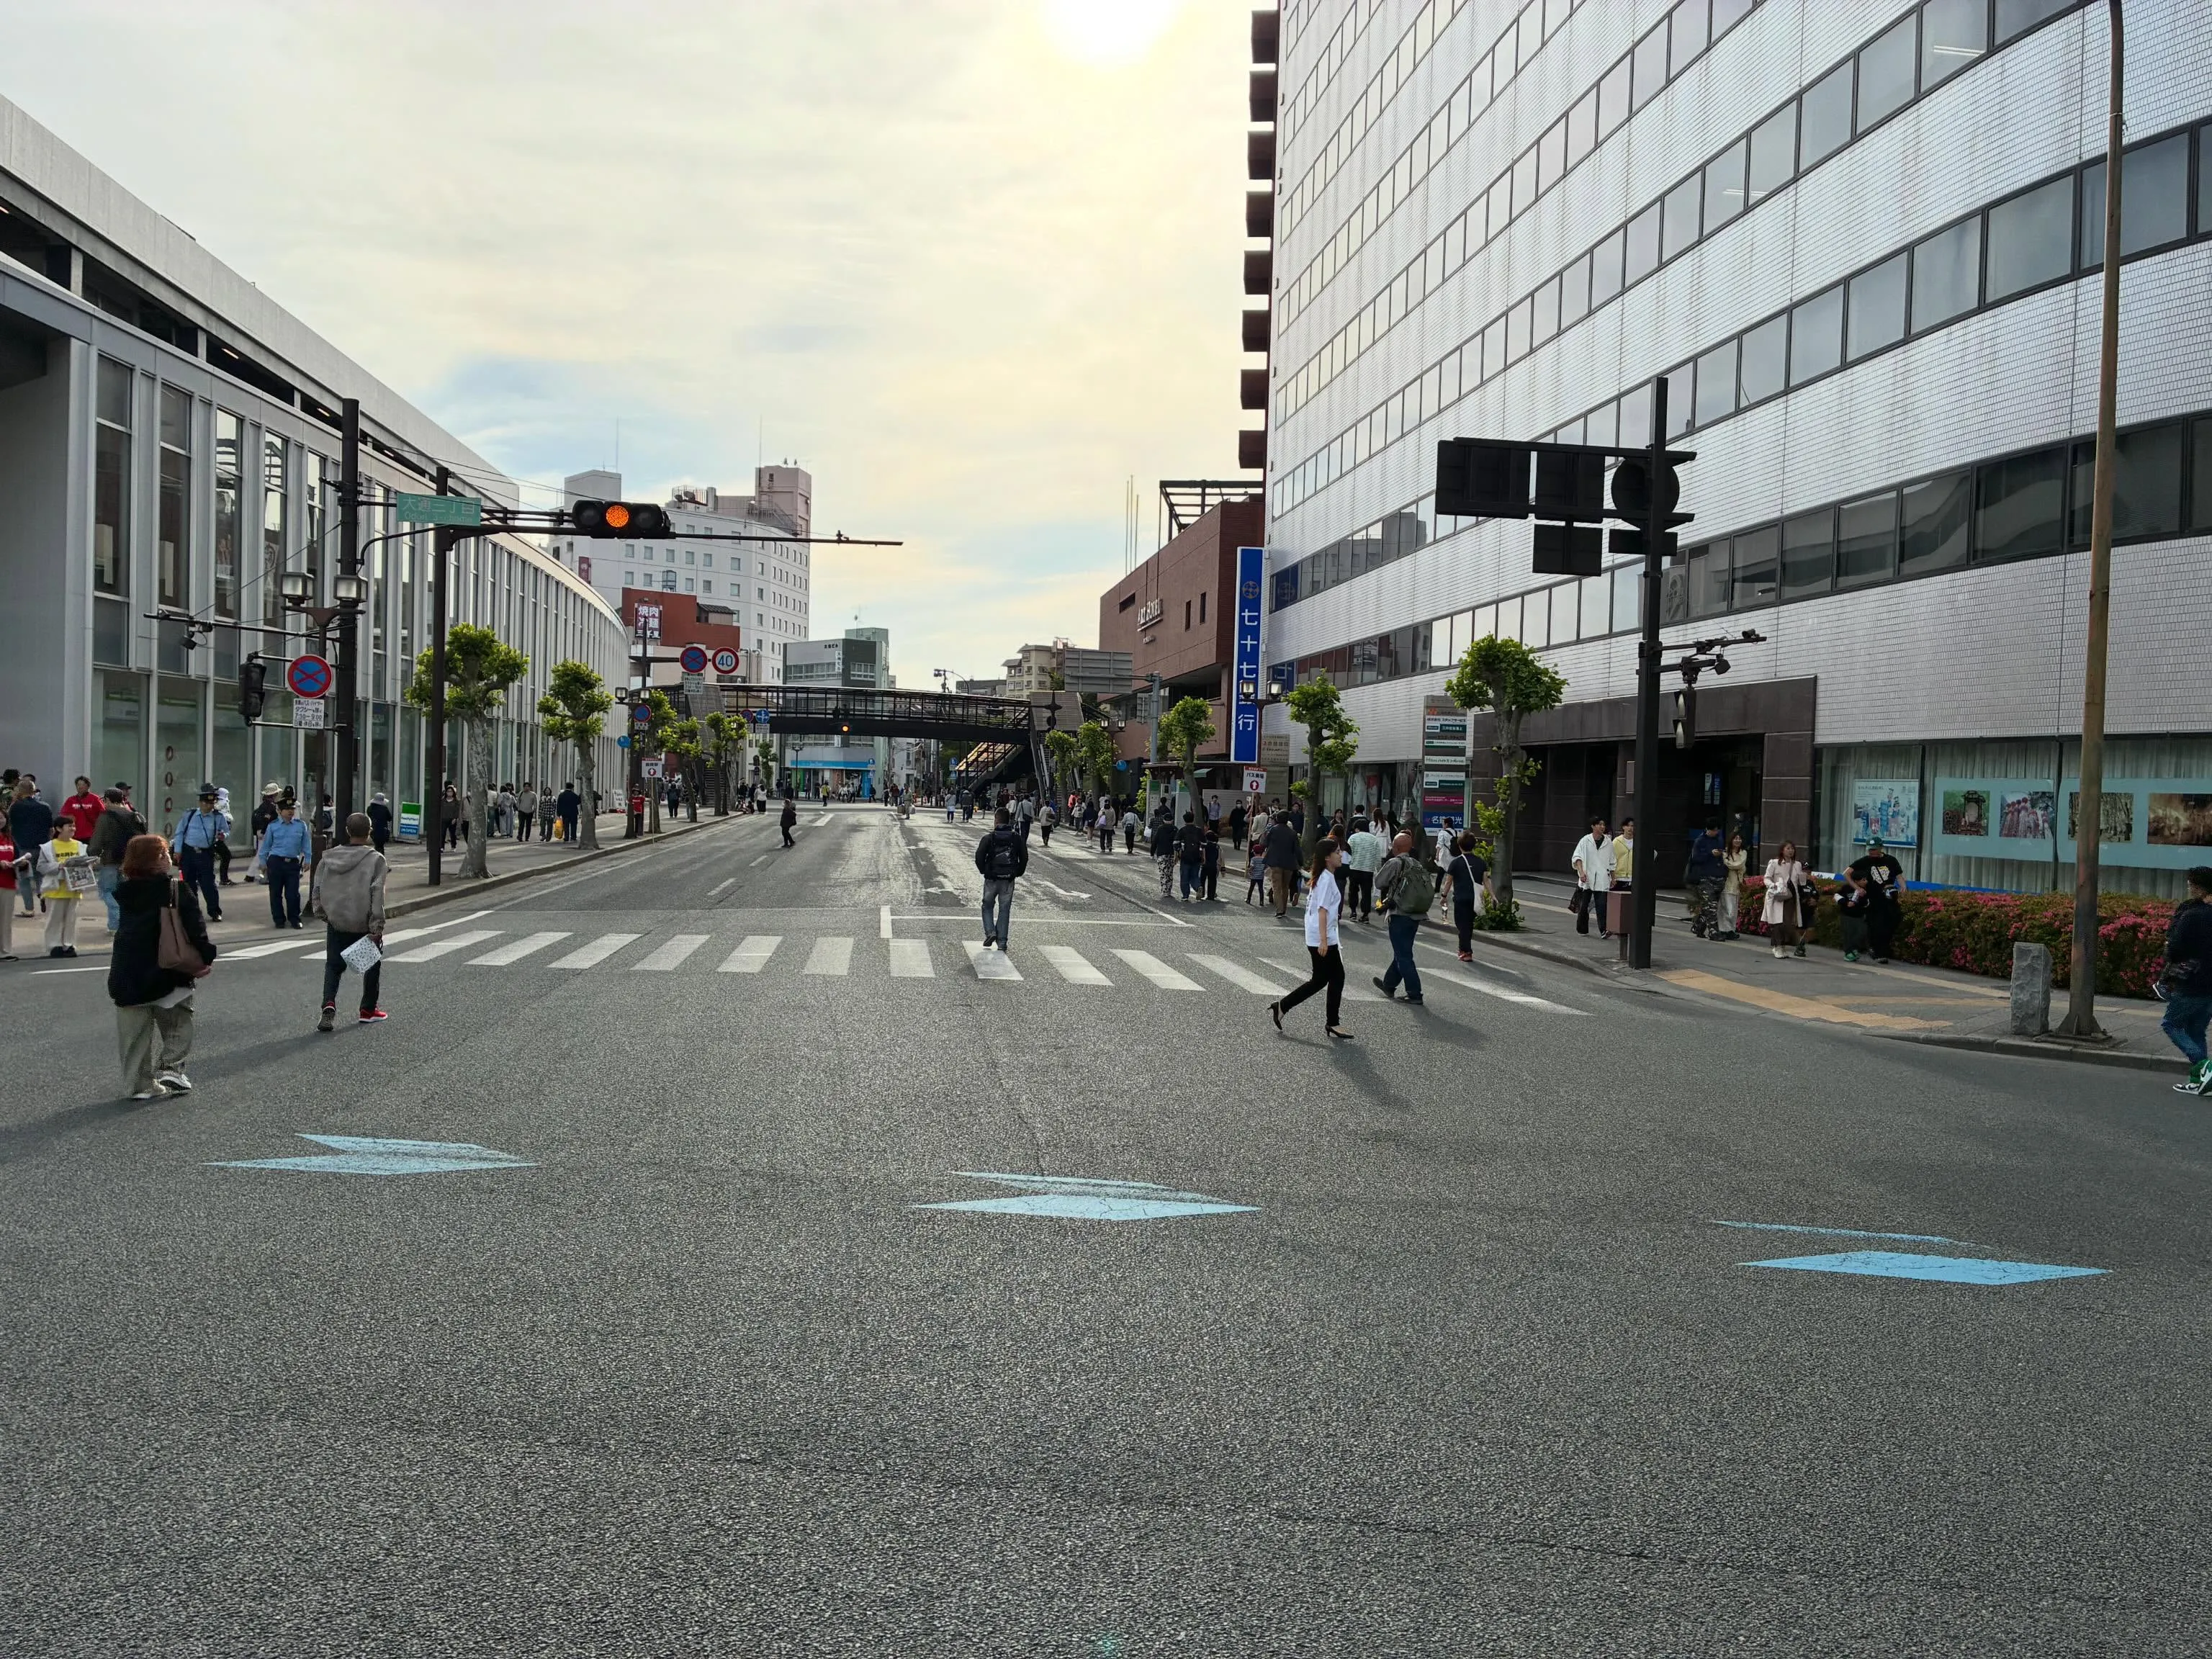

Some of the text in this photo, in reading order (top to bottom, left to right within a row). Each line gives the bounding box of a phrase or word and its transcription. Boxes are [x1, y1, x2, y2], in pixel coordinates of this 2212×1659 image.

[403, 497, 475, 513] 大通三丁目
[639, 606, 659, 617] 焼肉
[718, 655, 733, 667] 40
[1432, 816, 1462, 824] 名光
